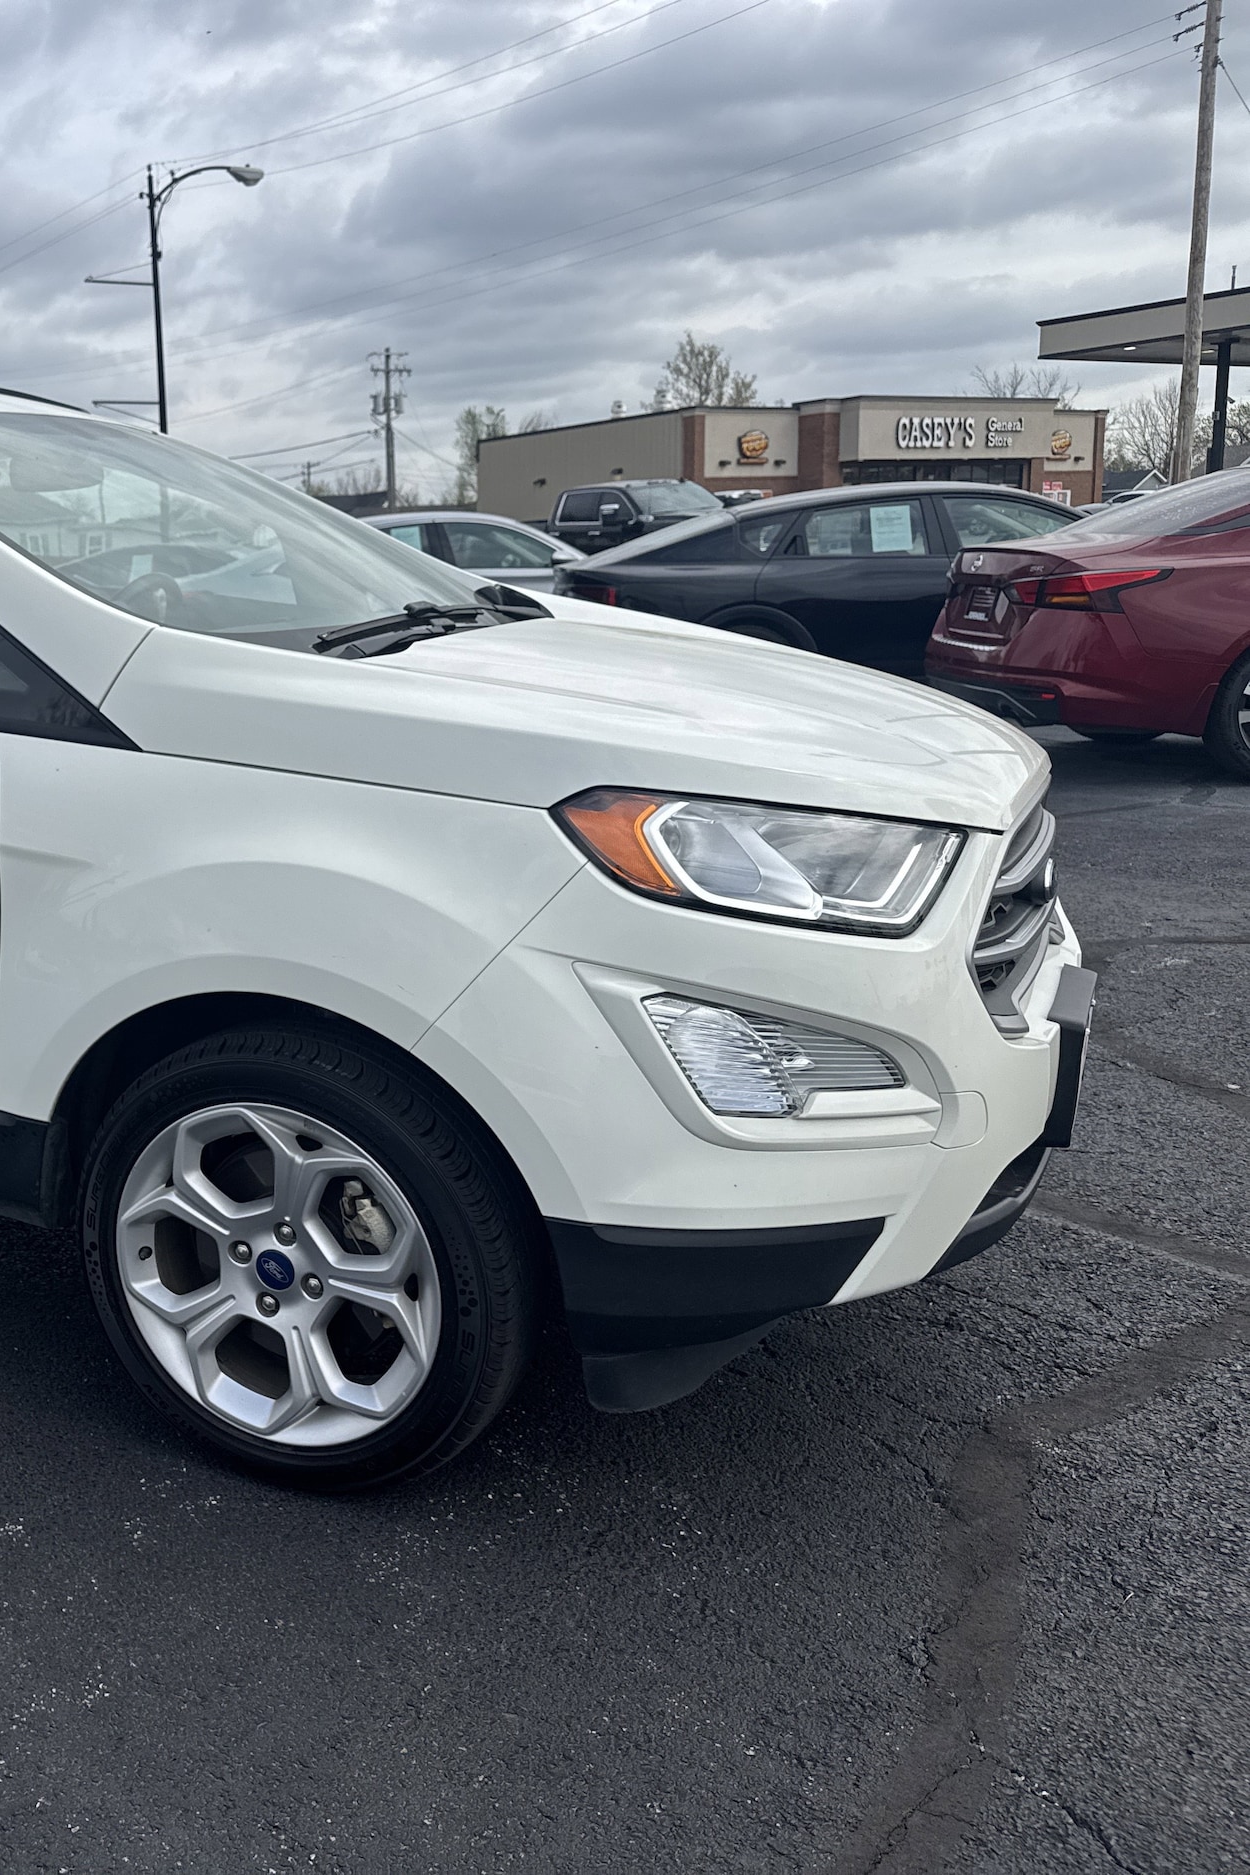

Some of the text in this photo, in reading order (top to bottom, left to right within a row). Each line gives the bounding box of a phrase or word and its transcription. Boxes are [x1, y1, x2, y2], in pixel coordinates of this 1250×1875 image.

[897, 416, 976, 448] CASEY'S
[987, 417, 1025, 432] General
[987, 432, 1013, 447] Store
